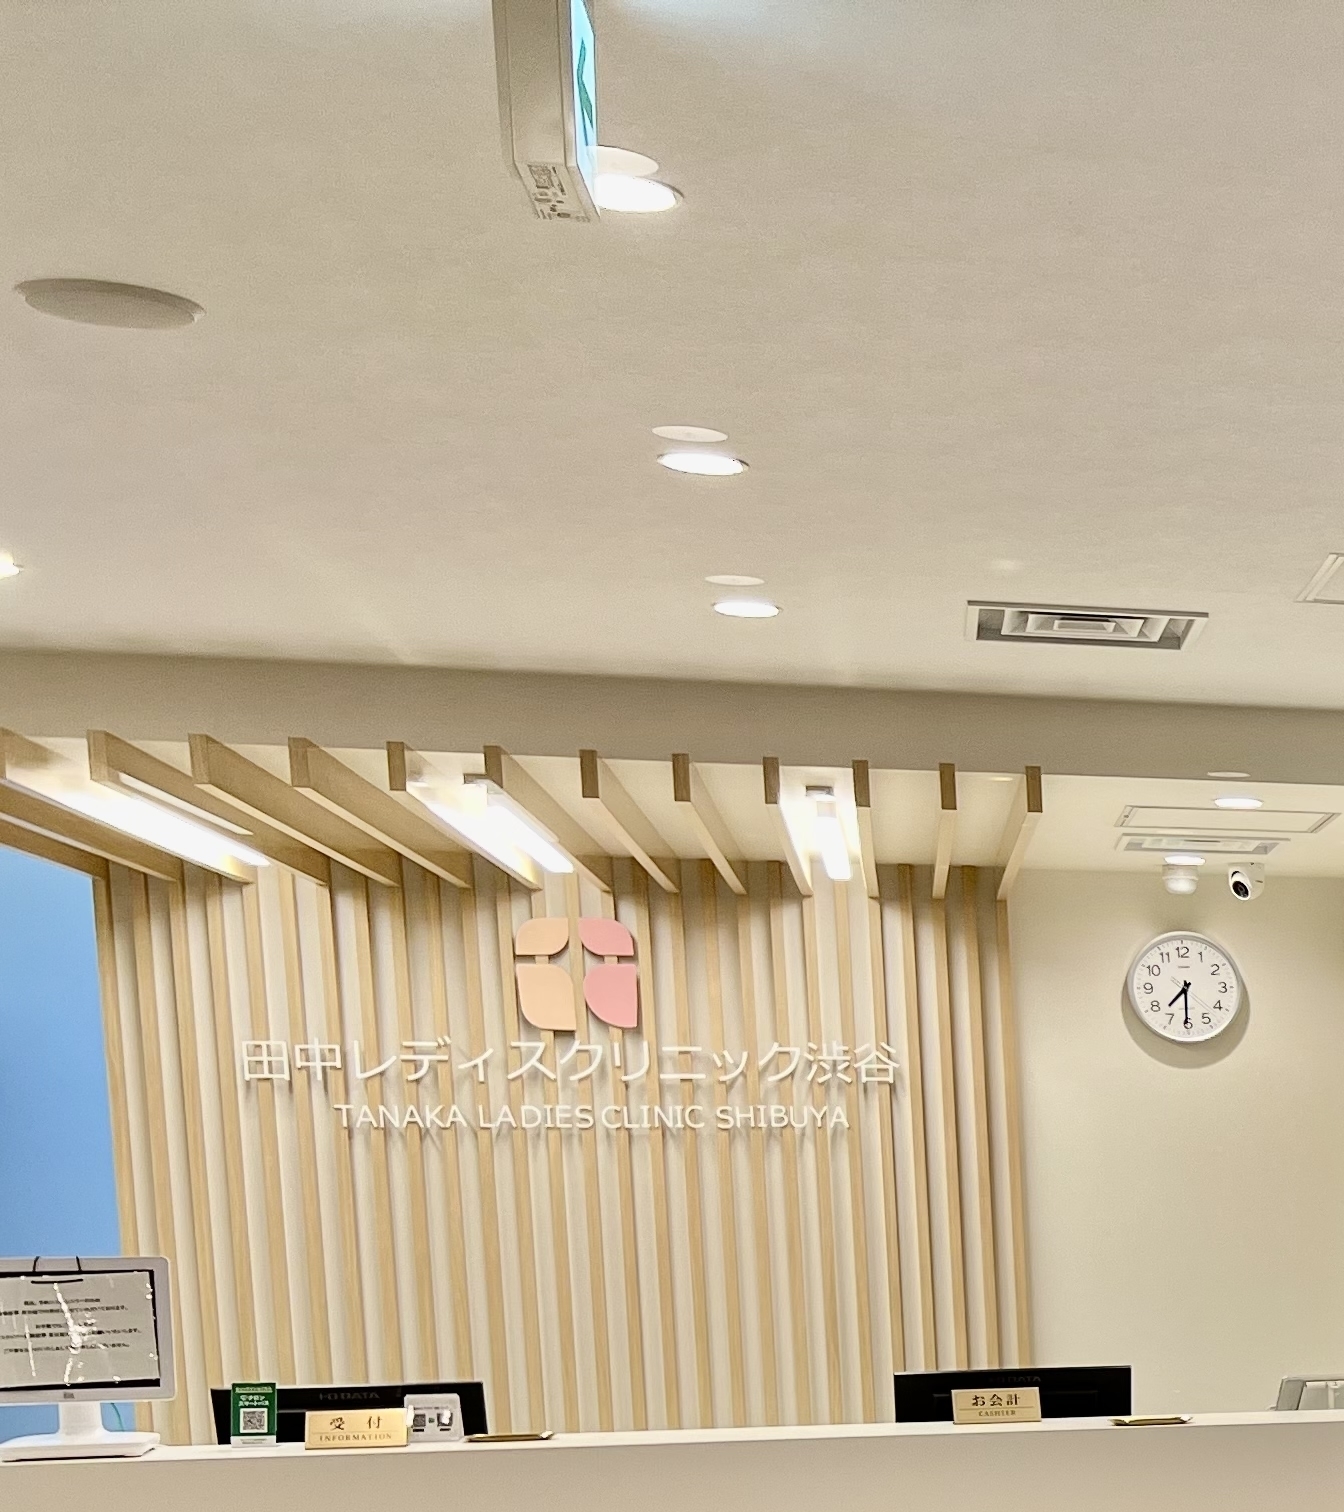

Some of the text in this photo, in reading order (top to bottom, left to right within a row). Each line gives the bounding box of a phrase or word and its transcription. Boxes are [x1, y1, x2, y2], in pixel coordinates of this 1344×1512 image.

[1159, 952, 1170, 963] 11
[1175, 946, 1190, 958] 12
[1146, 964, 1161, 976] 10
[1210, 963, 1221, 976] 2
[1143, 982, 1154, 994] 9
[1218, 981, 1228, 993] 3
[1150, 1000, 1161, 1012] 8
[1213, 1000, 1223, 1011] 4
[1165, 1013, 1175, 1025] 7
[1201, 1012, 1212, 1025] 5
[241, 1035, 900, 1083] 田中レディスクリニック渋谷
[332, 1103, 850, 1130] TANAKA LADIES CLINIC SHIBUYA
[971, 1393, 1020, 1407] お会計
[978, 1409, 1016, 1417] CASHIER
[329, 1415, 383, 1431] 受付
[319, 1432, 392, 1442] INFORMATION
